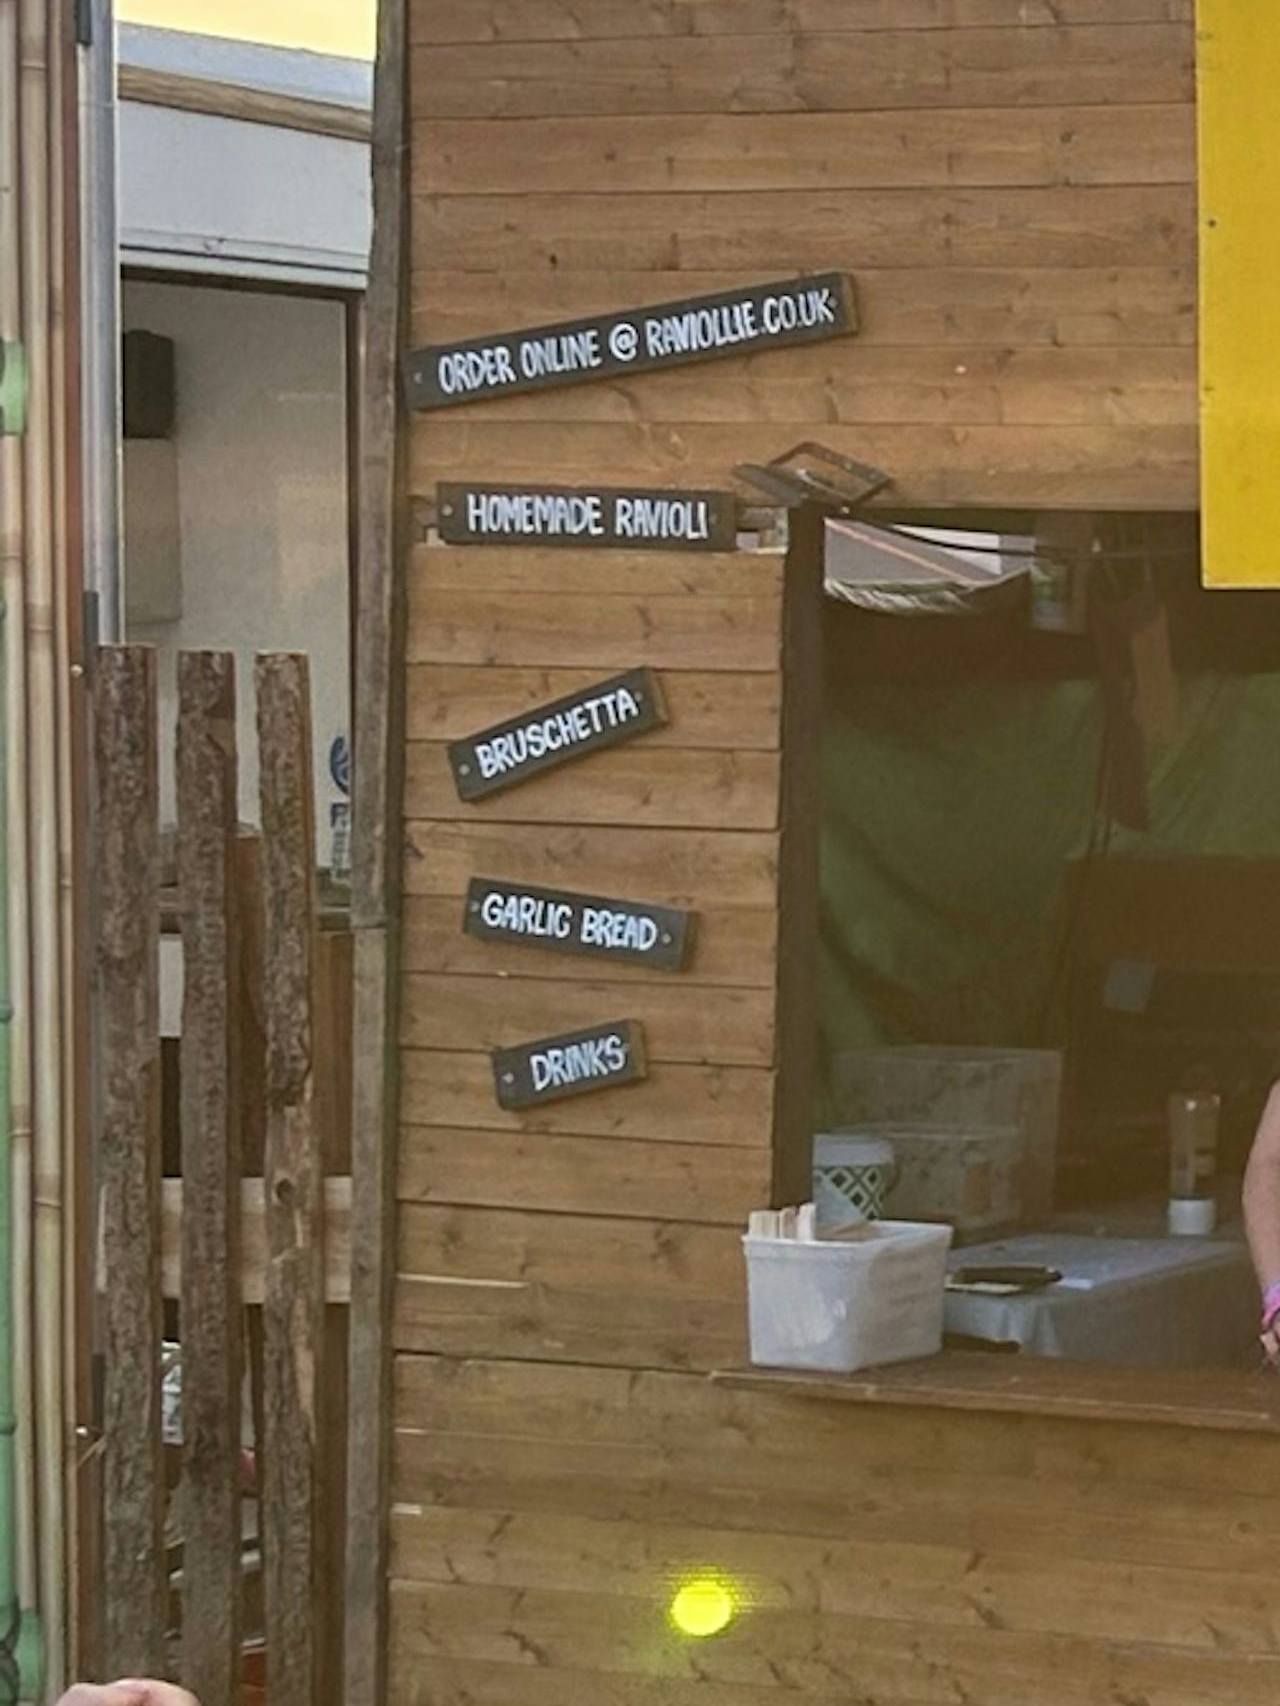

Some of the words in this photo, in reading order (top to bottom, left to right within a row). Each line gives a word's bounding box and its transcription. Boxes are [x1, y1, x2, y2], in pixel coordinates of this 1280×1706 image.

[438, 345, 516, 394] ORDER
[520, 330, 602, 379] ONLINE
[609, 322, 639, 362] @
[645, 287, 835, 358] RAVIOLLIE.CO.UK
[467, 493, 604, 535] HOMEMADE
[615, 498, 708, 540] RAVIOLI
[475, 688, 639, 779] BRUSCHETTA
[481, 893, 571, 939] GARLIC
[580, 907, 657, 951] BREAD
[530, 1035, 627, 1091] DRINKS
